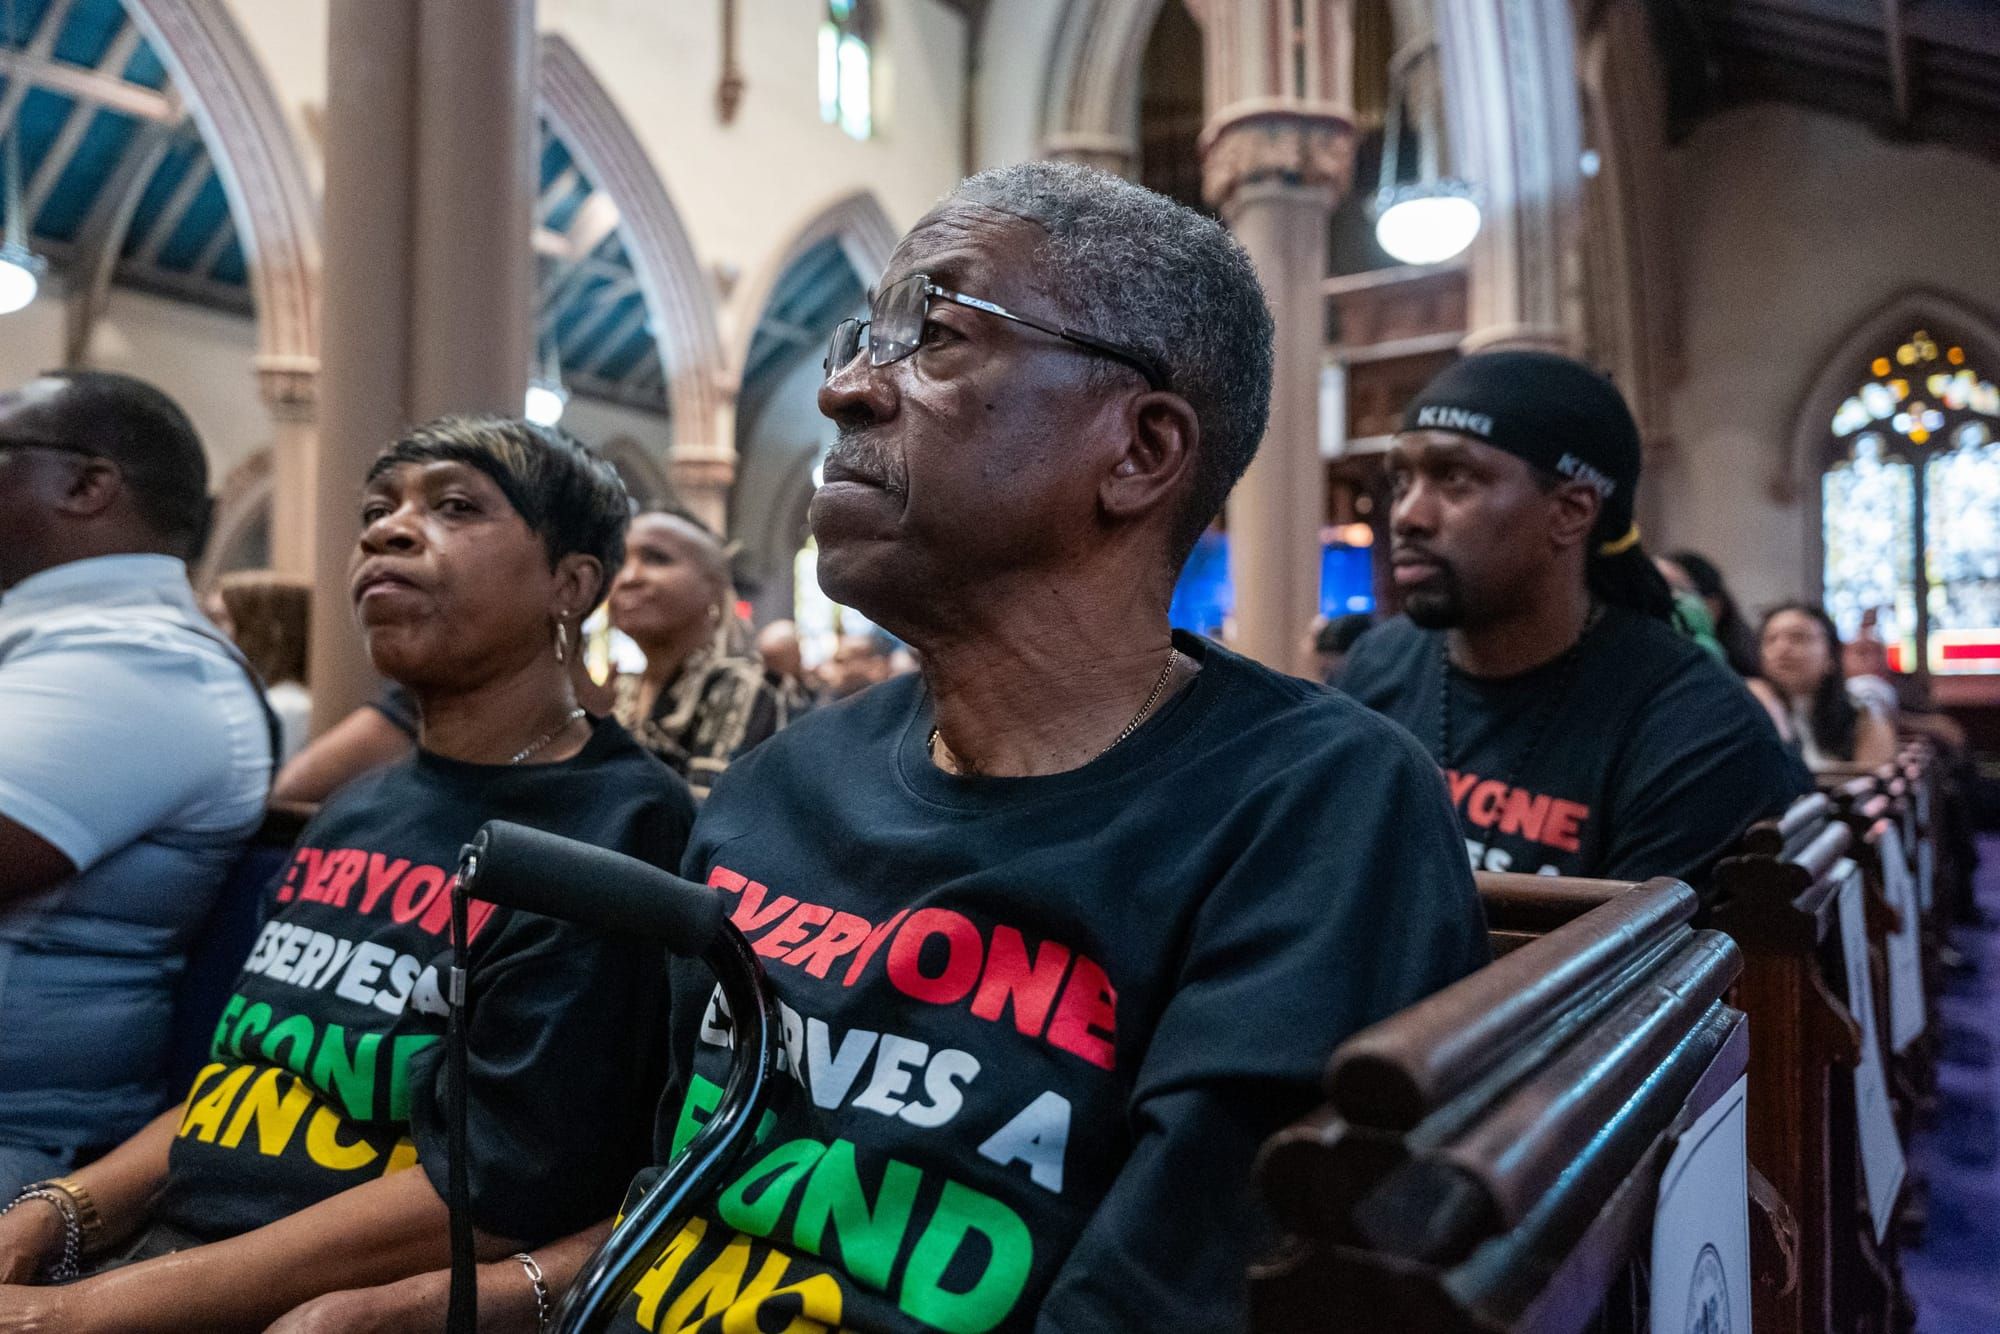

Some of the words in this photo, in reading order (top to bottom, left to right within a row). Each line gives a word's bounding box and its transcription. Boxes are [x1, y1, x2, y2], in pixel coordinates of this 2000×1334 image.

[1418, 406, 1493, 437] KING
[1446, 768, 1590, 853] YONE
[243, 920, 422, 1016] ESERVES
[978, 1091, 1072, 1194] A
